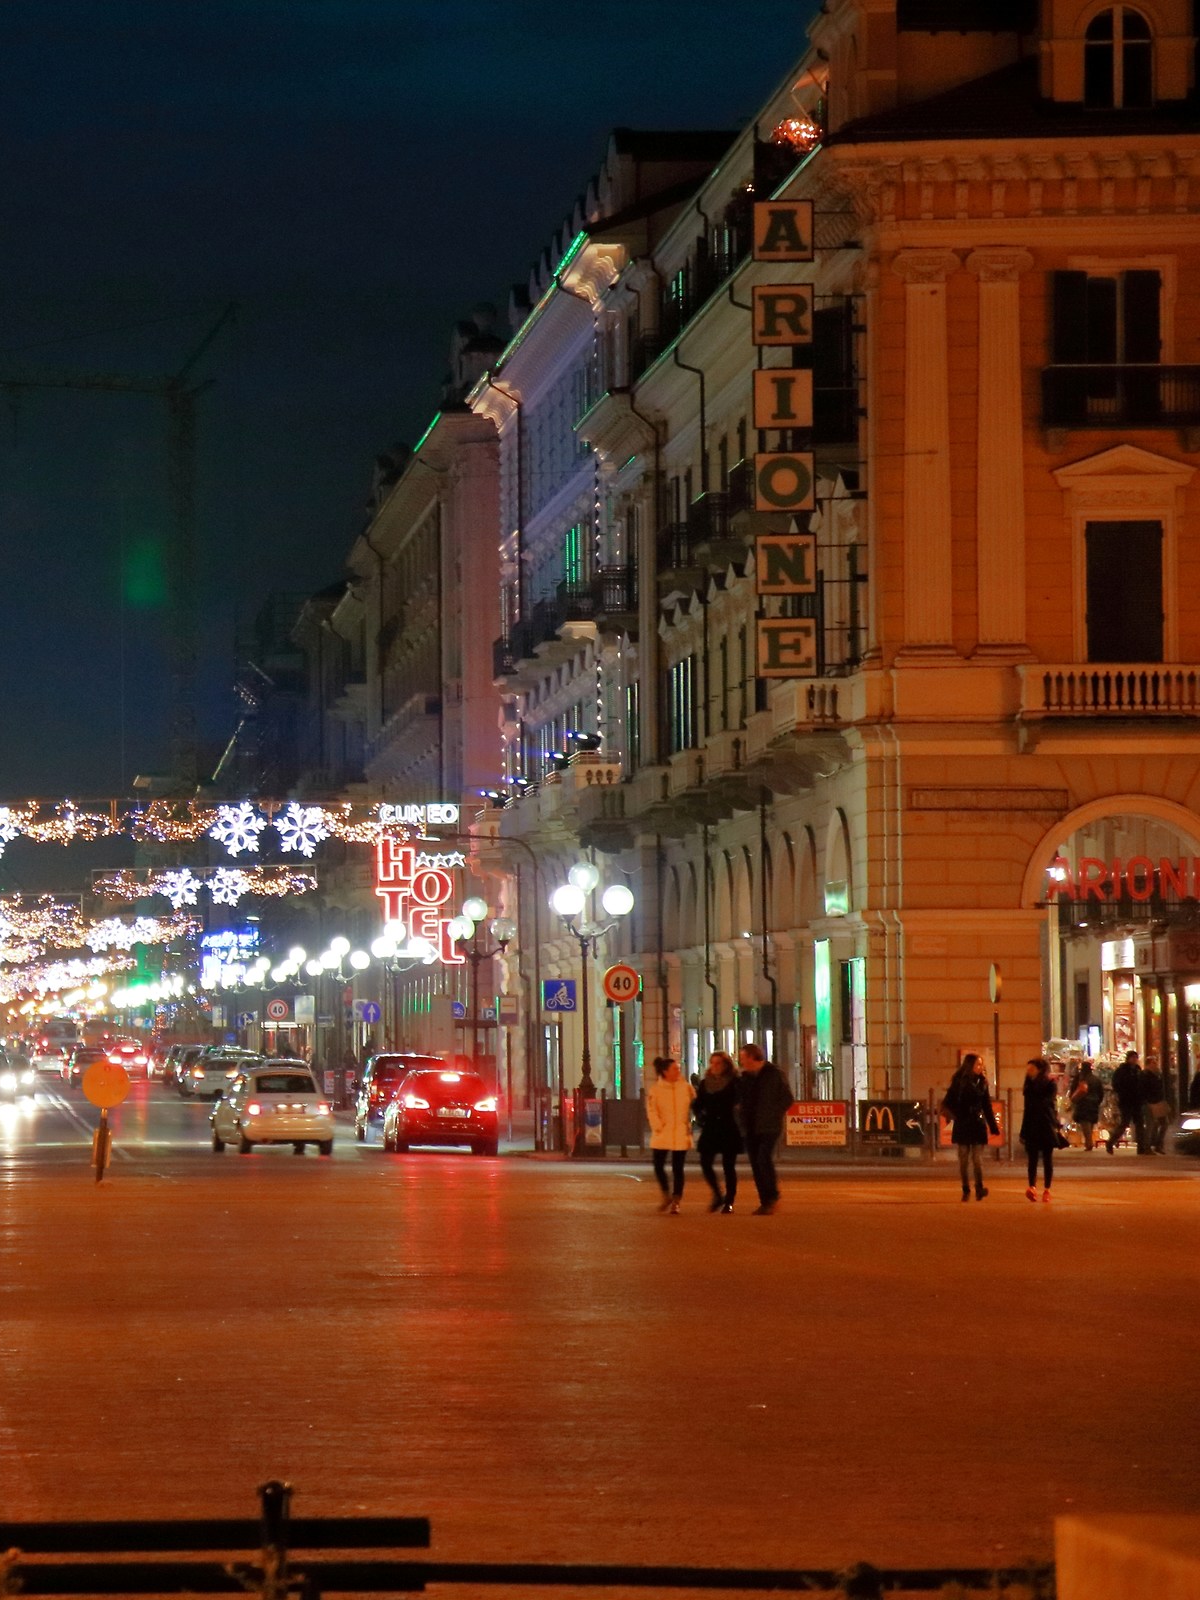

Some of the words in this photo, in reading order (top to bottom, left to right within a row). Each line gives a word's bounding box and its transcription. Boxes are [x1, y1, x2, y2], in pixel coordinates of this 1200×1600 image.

[758, 207, 812, 670] ARIONE
[379, 803, 459, 824] CUNEO
[375, 835, 466, 964] HOTEL
[613, 976, 631, 991] 40
[272, 1006, 283, 1014] 40
[798, 1105, 833, 1115] BERTI
